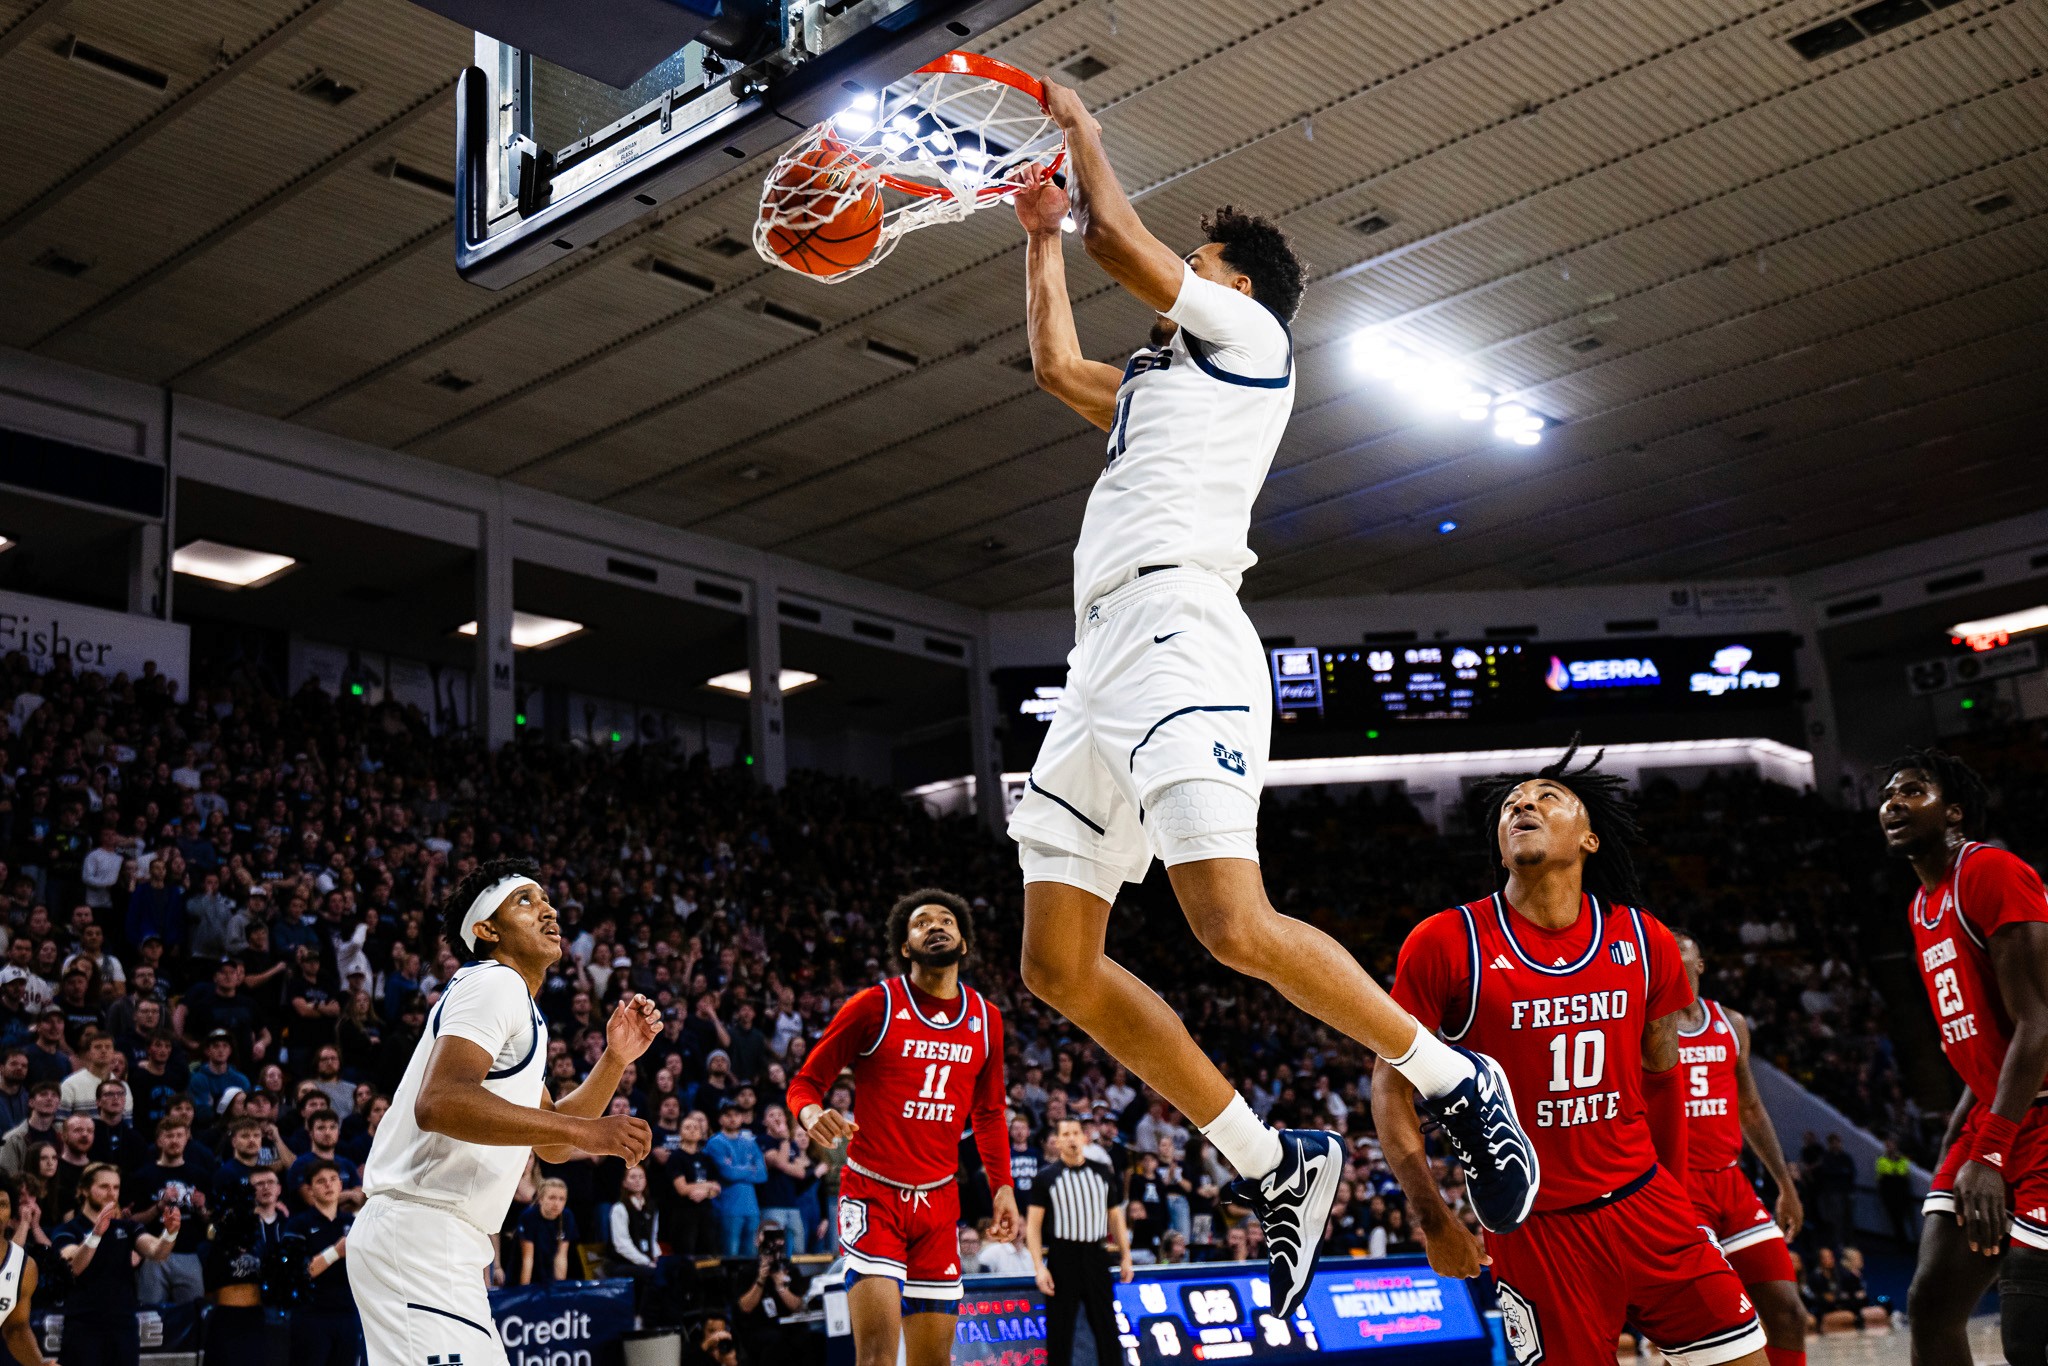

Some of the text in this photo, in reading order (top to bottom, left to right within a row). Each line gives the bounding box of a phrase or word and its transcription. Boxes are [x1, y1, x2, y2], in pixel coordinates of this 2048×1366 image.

[0, 614, 113, 666] Fisher
[1568, 657, 1659, 682] SIERRA
[1690, 670, 1780, 695] Sign Pro
[1213, 747, 1248, 771] STATE
[1934, 967, 1965, 1018] 23
[1510, 989, 1629, 1030] FRESNO
[901, 1039, 974, 1064] FRESNO
[1548, 1029, 1606, 1093] 10
[1677, 1045, 1727, 1065] RESNO
[918, 1063, 952, 1100] 11
[1689, 1065, 1710, 1098] 5
[902, 1100, 956, 1123] STATE
[1536, 1090, 1621, 1128] STATE
[1332, 1288, 1444, 1319] METALMART
[500, 1308, 592, 1348] Credit
[956, 1315, 1047, 1344] TALMA
